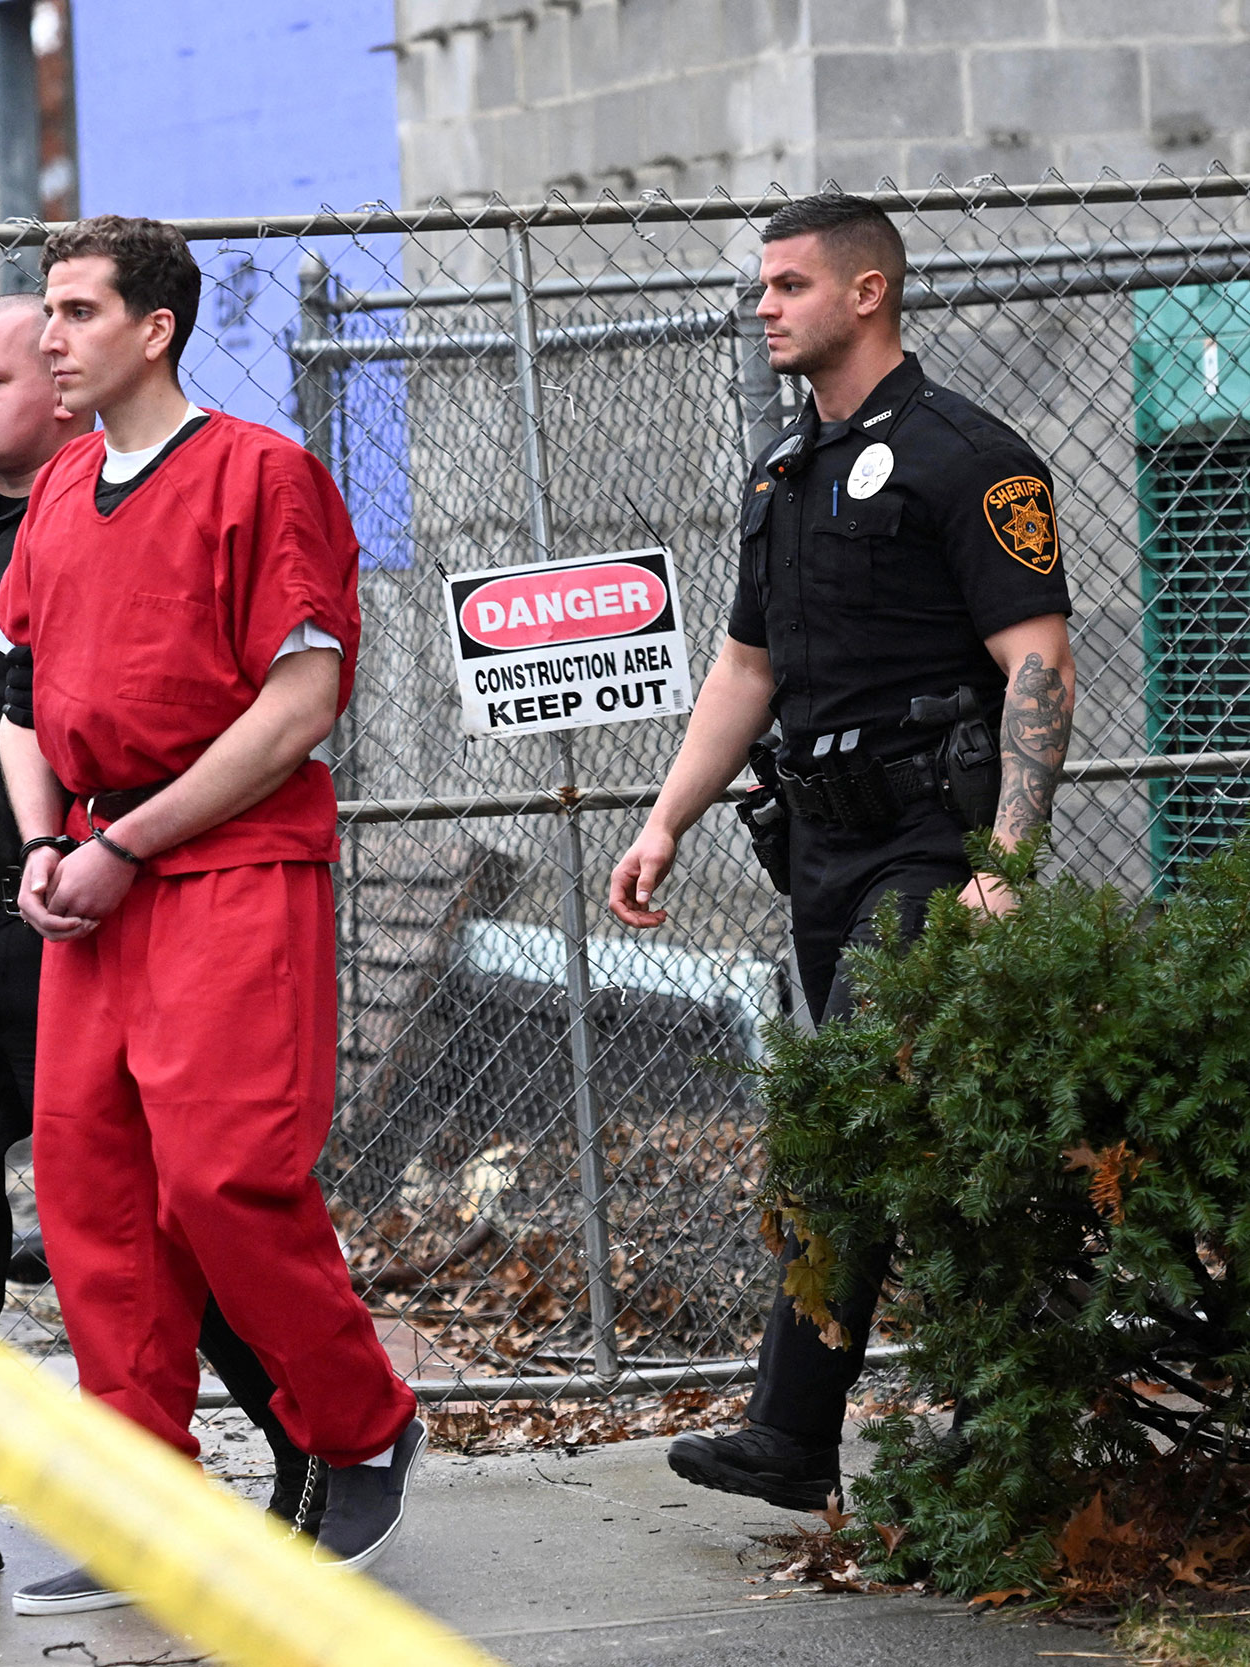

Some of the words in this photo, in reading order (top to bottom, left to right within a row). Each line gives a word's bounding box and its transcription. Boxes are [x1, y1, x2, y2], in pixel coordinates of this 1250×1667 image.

[989, 481, 1042, 510] SHERIFF
[476, 581, 651, 633] DANGER
[475, 651, 617, 695] CONSTRUCTION
[624, 645, 673, 675] AREA
[488, 690, 582, 728] KEEP
[595, 679, 667, 712] OUT
